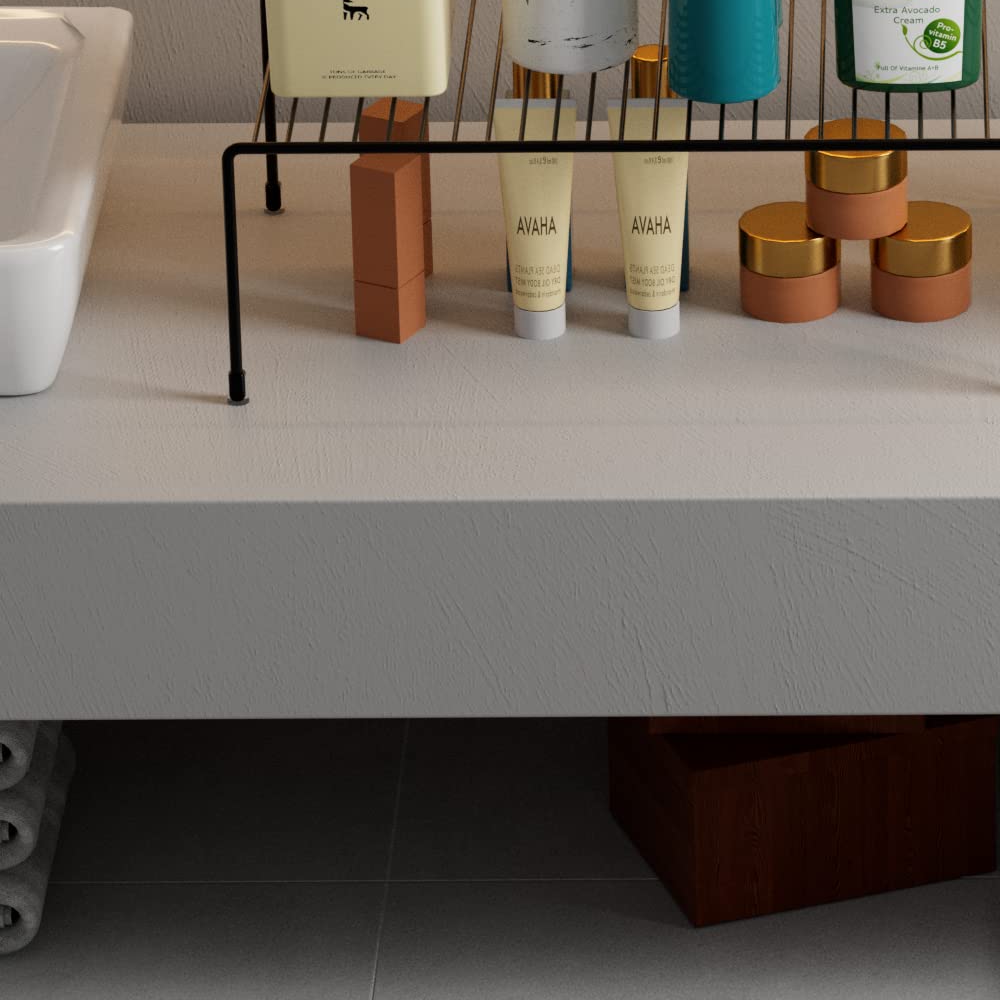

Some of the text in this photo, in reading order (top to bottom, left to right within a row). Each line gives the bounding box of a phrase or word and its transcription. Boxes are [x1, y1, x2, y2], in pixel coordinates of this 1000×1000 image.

[873, 5, 941, 15] Extra Avocado
[893, 16, 924, 25] Cream
[936, 21, 955, 32] Pro-
[928, 29, 958, 42] vitamin
[932, 39, 947, 50] B5
